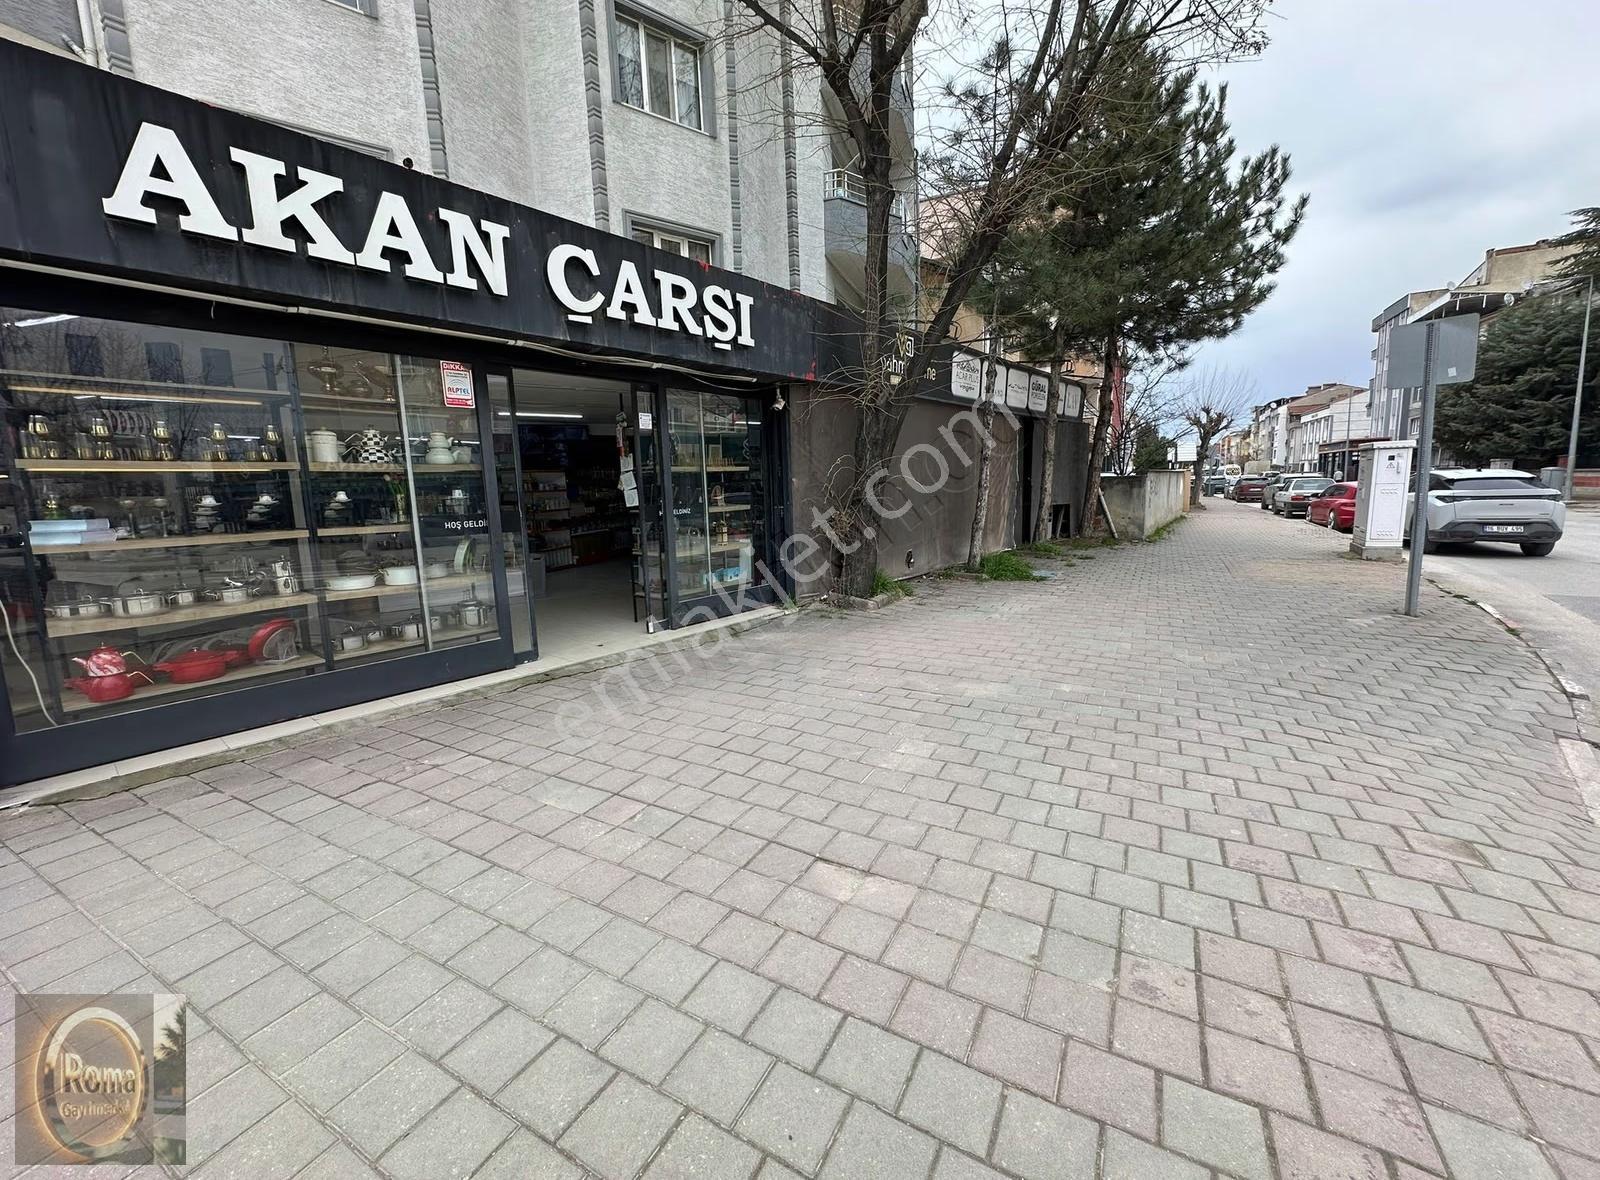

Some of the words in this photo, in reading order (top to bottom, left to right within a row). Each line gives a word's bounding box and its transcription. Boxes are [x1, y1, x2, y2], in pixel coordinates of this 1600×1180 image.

[102, 121, 510, 298] AKAN
[546, 243, 756, 350] ÇARŞI
[444, 520, 462, 530] HOŞ
[463, 518, 488, 529] GELDİ
